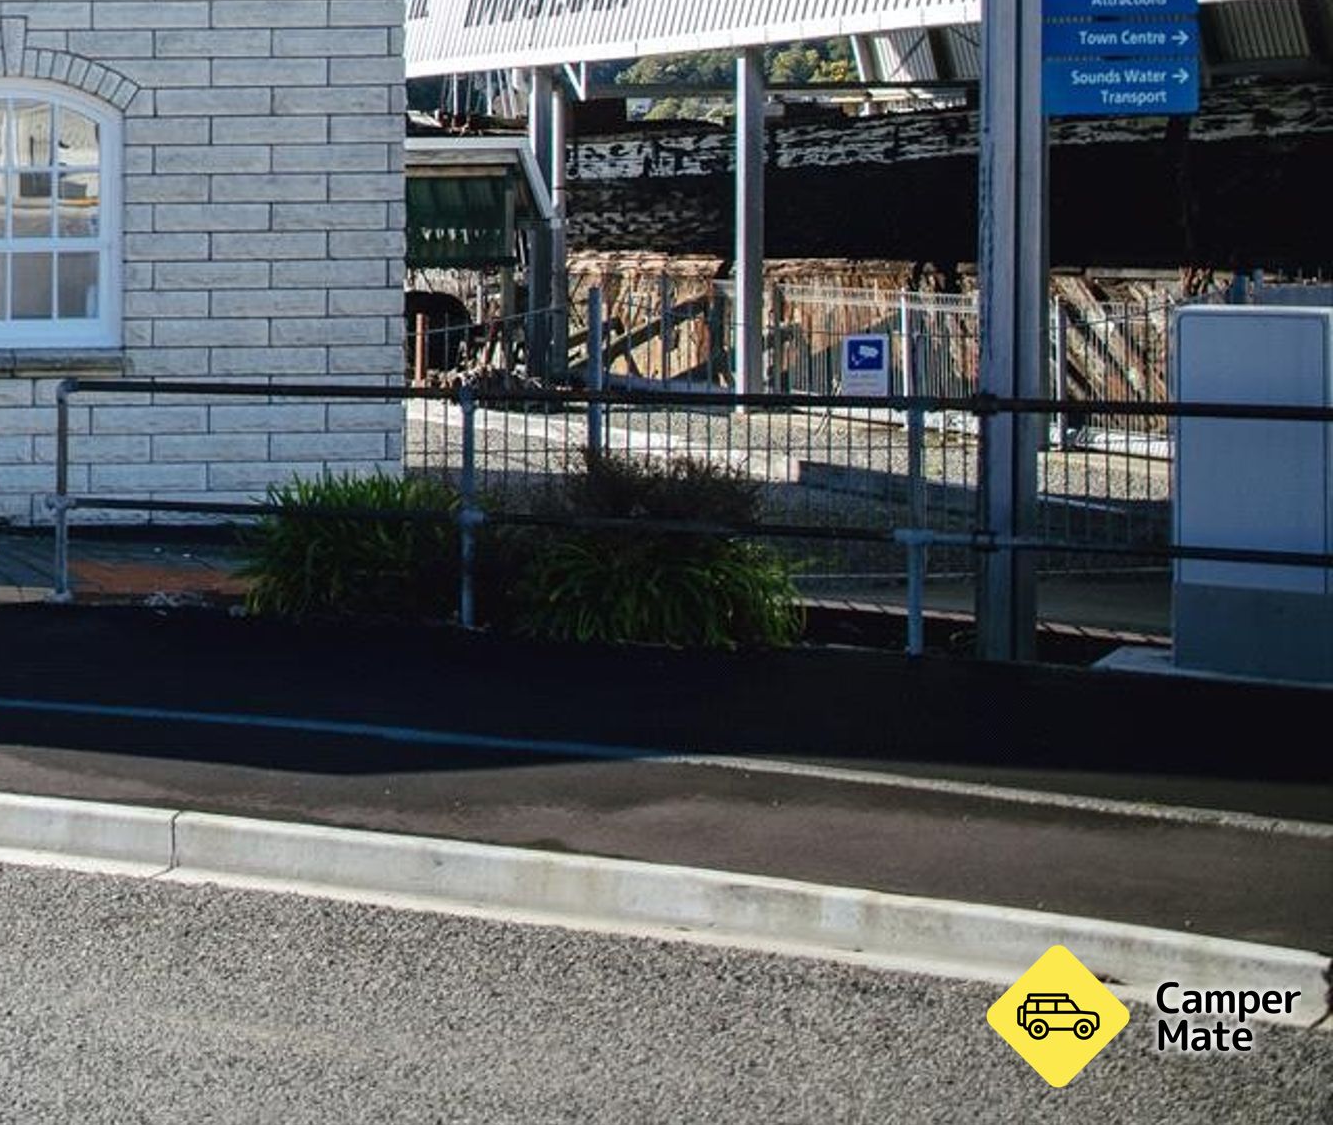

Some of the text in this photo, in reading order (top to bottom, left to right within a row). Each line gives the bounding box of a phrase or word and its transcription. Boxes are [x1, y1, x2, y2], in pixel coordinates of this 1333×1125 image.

[1080, 30, 1166, 44] Town Centre
[1071, 70, 1166, 84] Sounds Water
[1101, 91, 1166, 106] Transport
